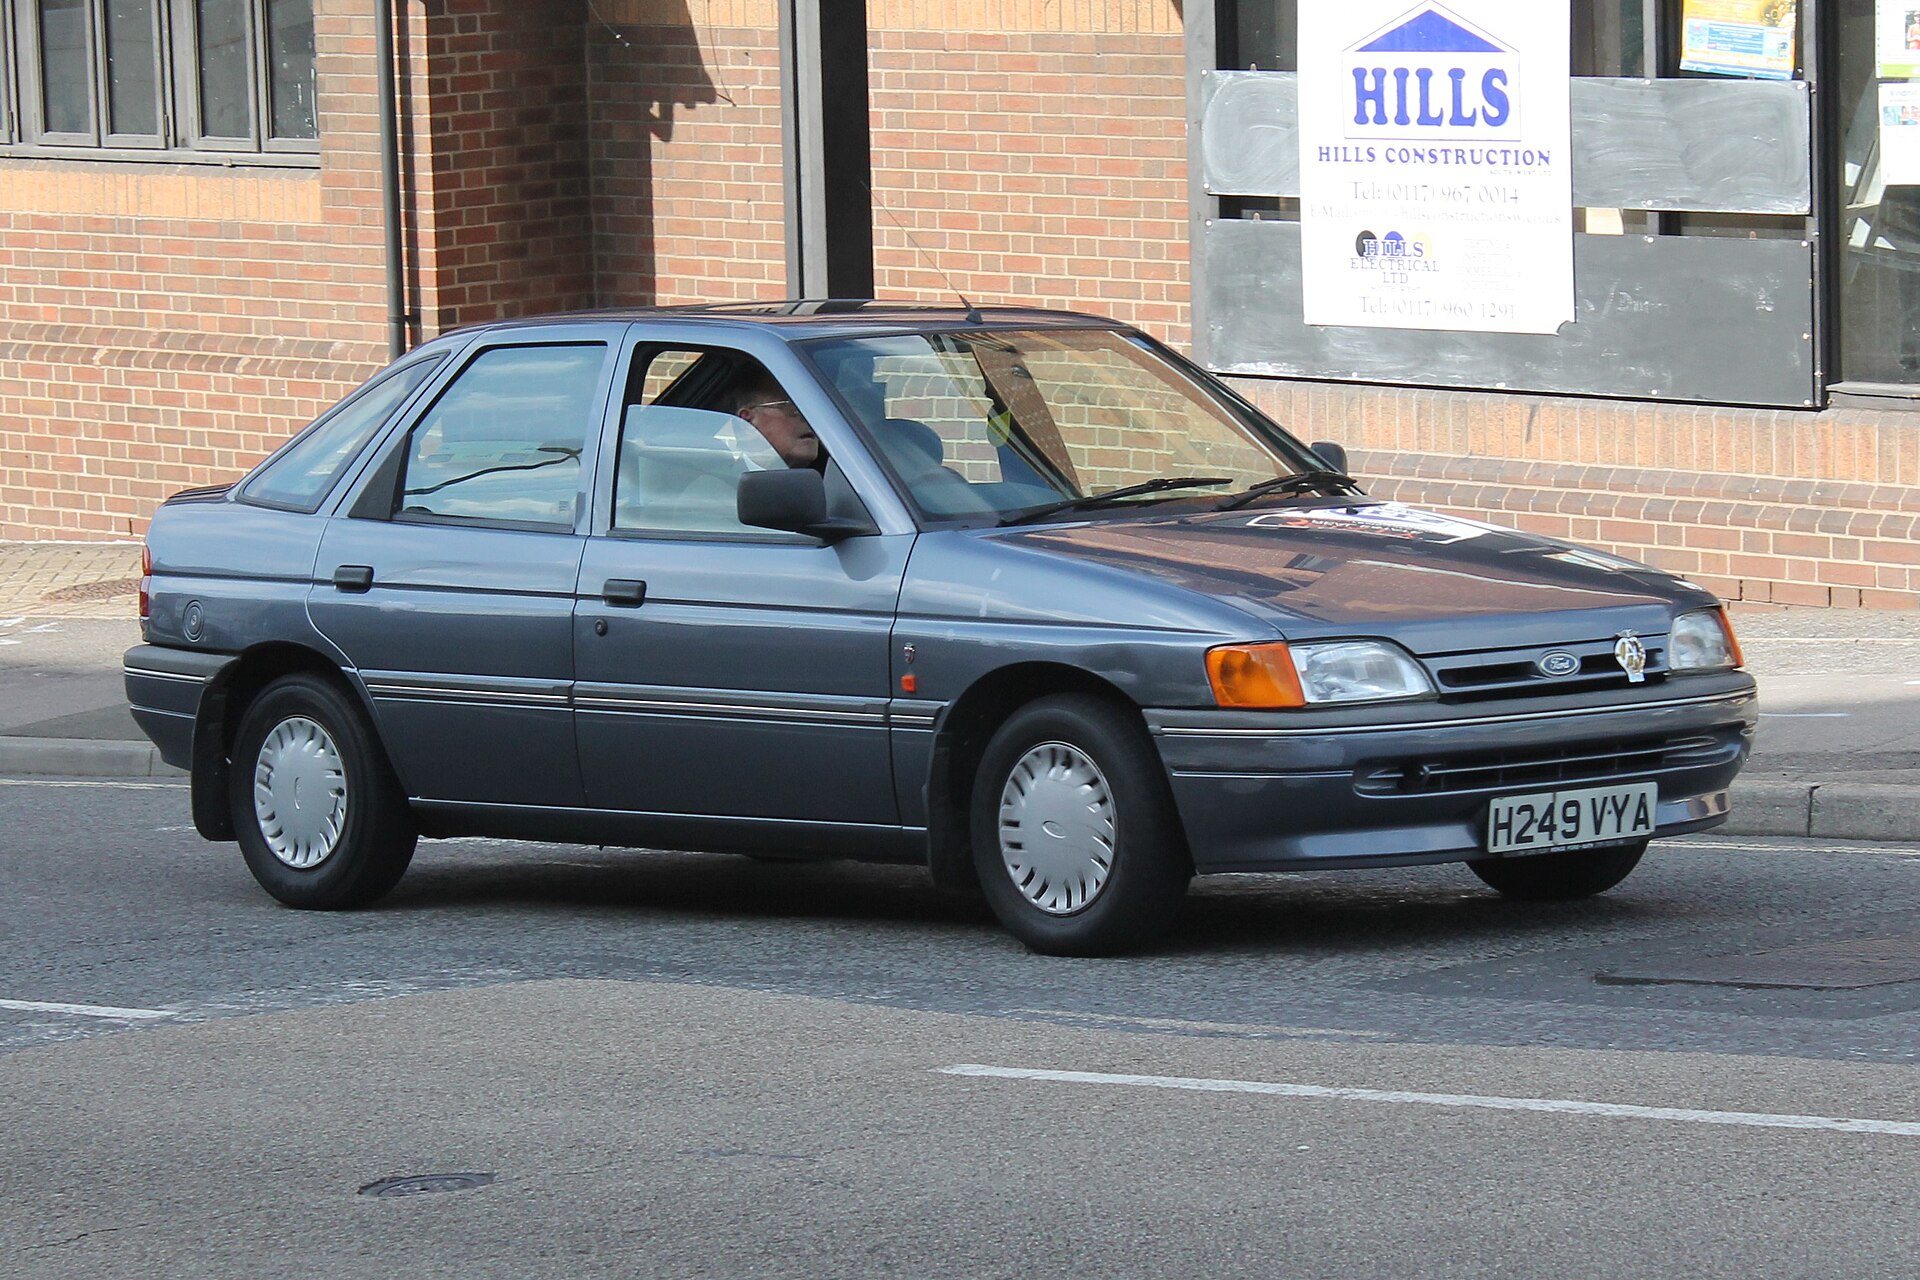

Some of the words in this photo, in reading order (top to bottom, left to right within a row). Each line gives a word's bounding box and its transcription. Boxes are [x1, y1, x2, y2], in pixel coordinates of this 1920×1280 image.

[1352, 67, 1510, 127] HILLS
[1317, 146, 1376, 162] HILLS
[1385, 147, 1551, 166] CONSTRUCTION
[1350, 181, 1381, 200] Tel:
[1440, 185, 1472, 203] 967
[1362, 239, 1424, 258] HILLS
[1350, 257, 1440, 272] ELECTRICAL
[1382, 272, 1409, 284] LTD
[1358, 296, 1387, 314] Tel:
[1492, 800, 1581, 847] H249
[1590, 792, 1651, 836] VYA
